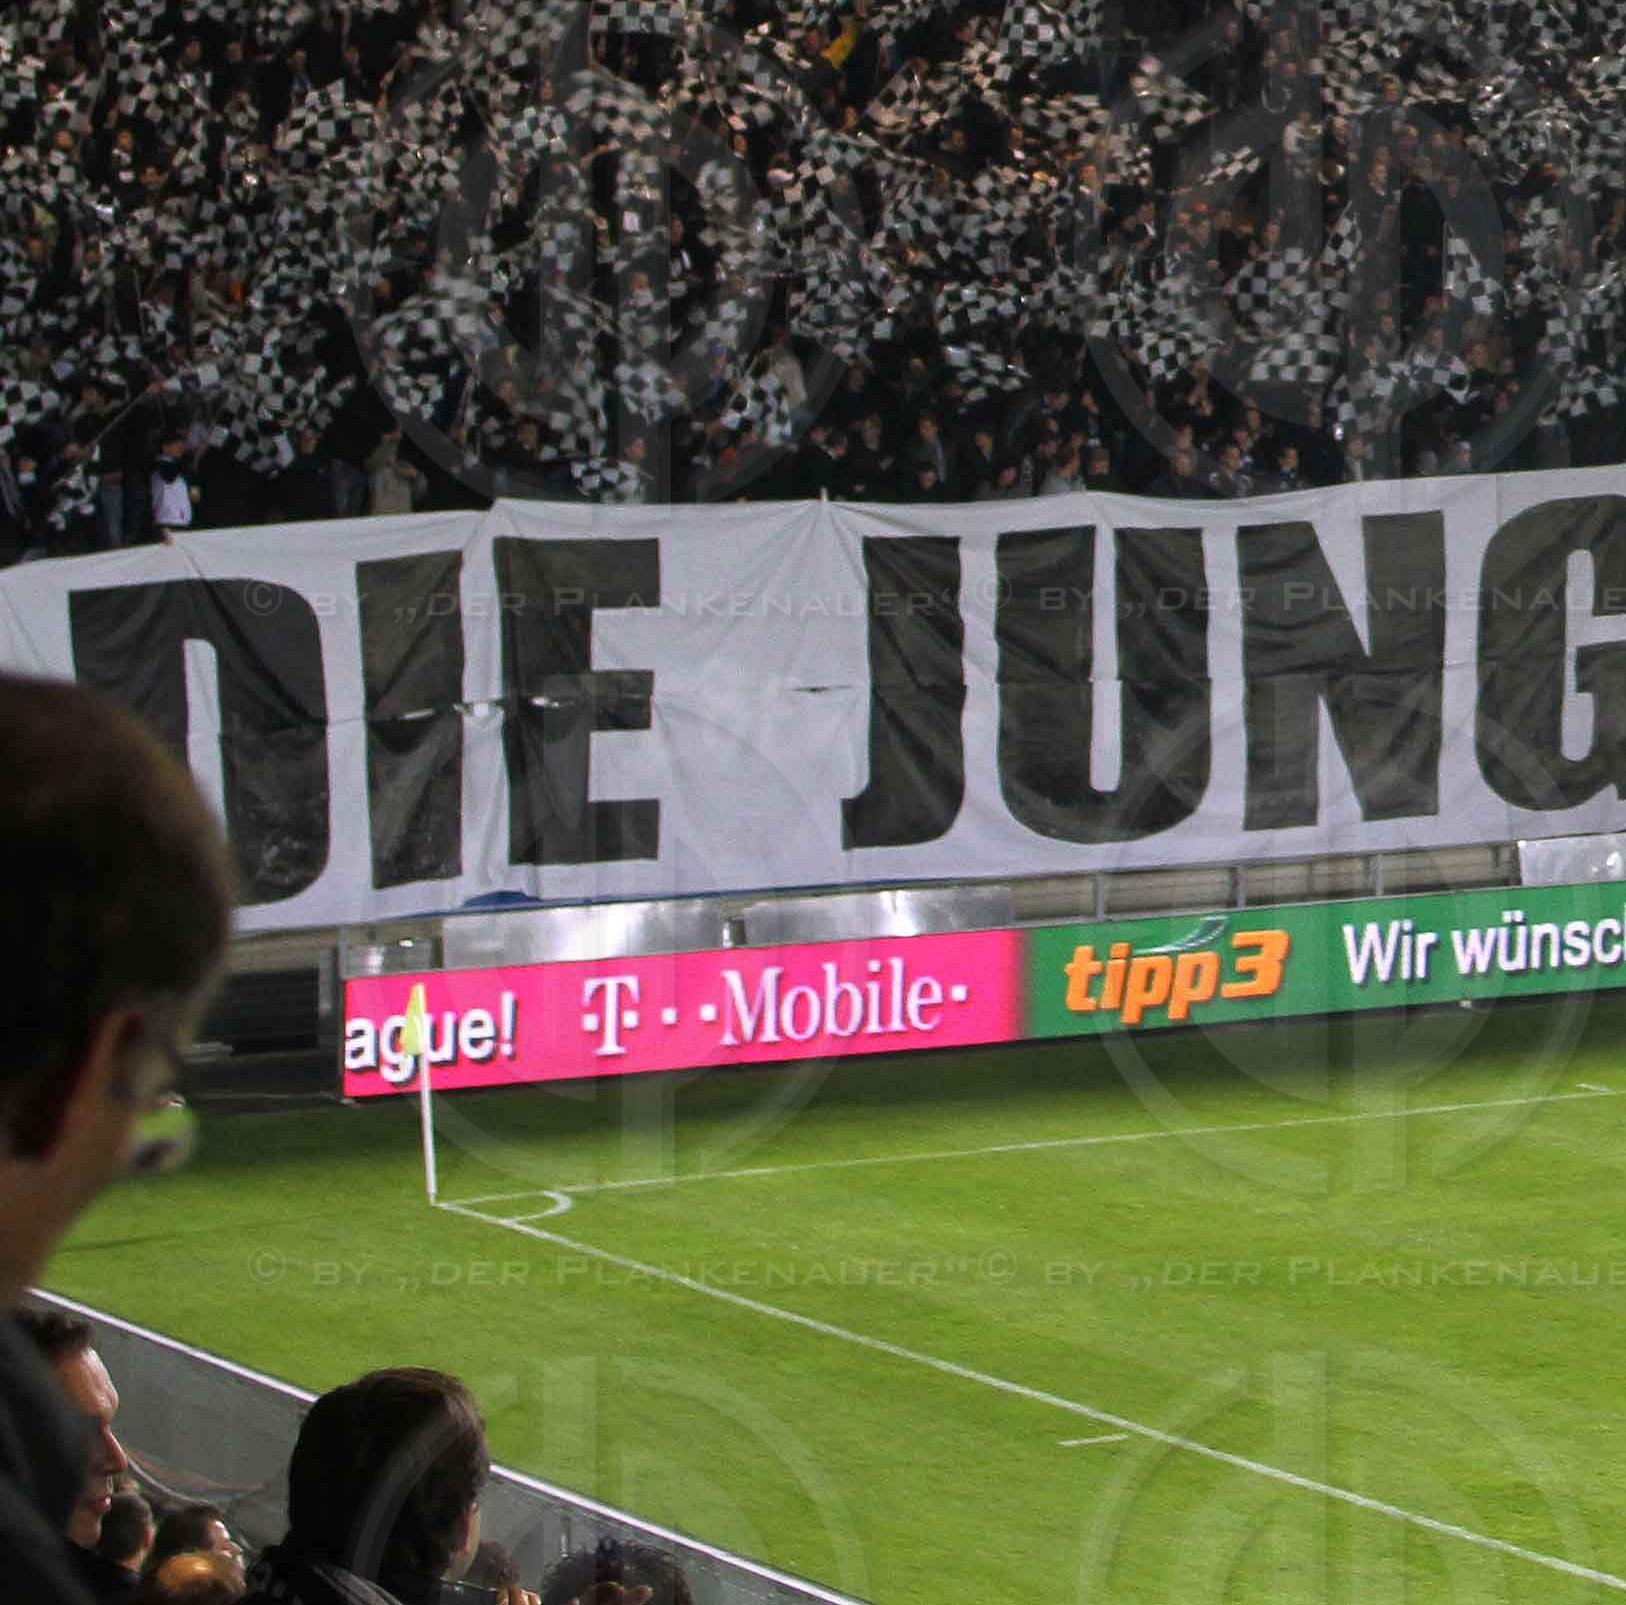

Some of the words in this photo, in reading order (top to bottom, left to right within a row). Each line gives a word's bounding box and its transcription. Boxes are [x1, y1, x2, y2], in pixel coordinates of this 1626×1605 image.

[69, 536, 661, 906] DIE
[1063, 928, 1290, 1025] tipp3
[1342, 919, 1440, 985] Wir
